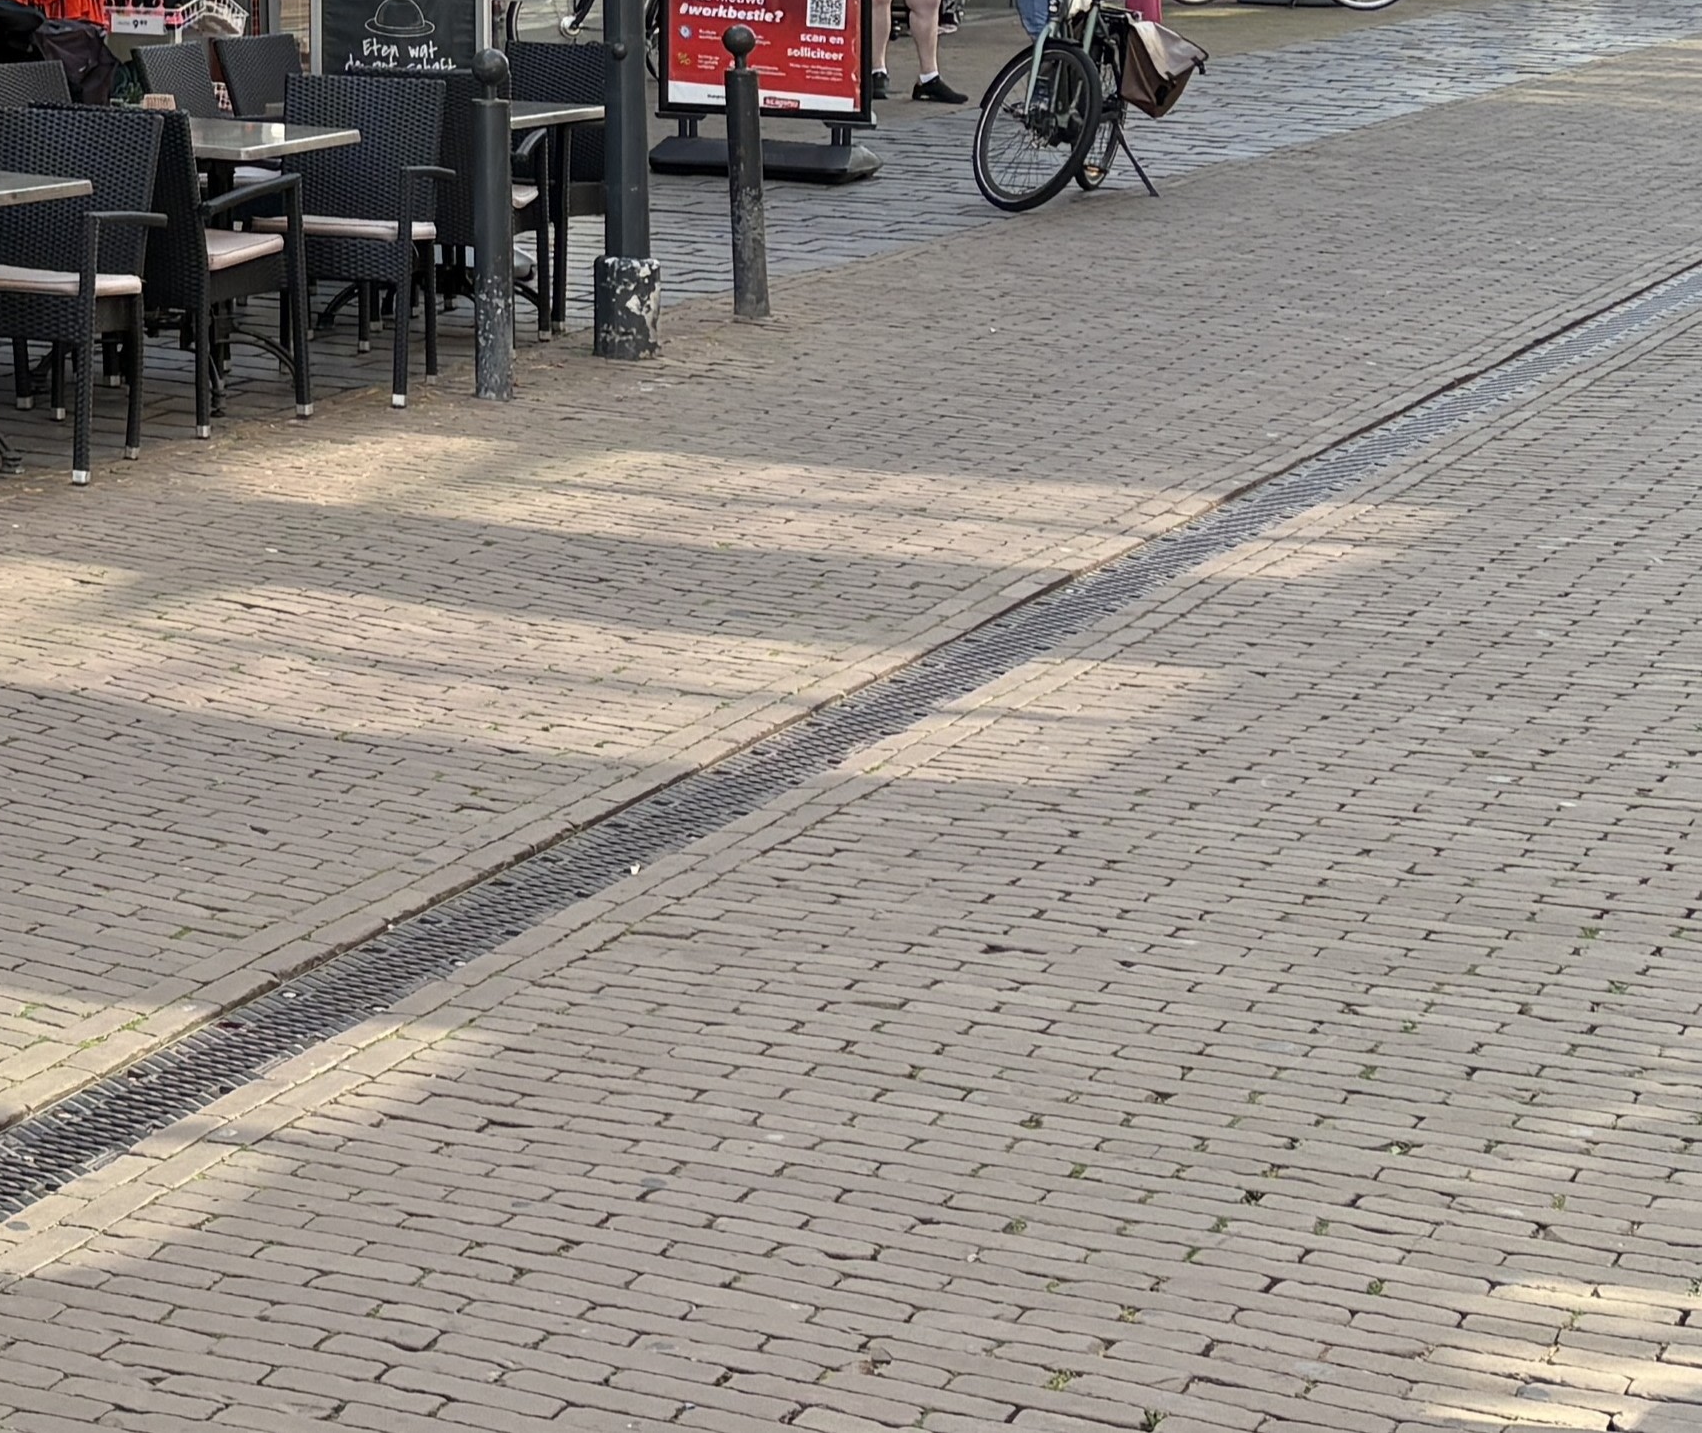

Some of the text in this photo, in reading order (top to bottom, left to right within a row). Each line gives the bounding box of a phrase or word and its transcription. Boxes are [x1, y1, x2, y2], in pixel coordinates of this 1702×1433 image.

[679, 2, 784, 23] #workbestie?
[800, 33, 844, 45] scan en
[362, 37, 438, 60] Eten wat
[787, 48, 844, 61] solliciteer
